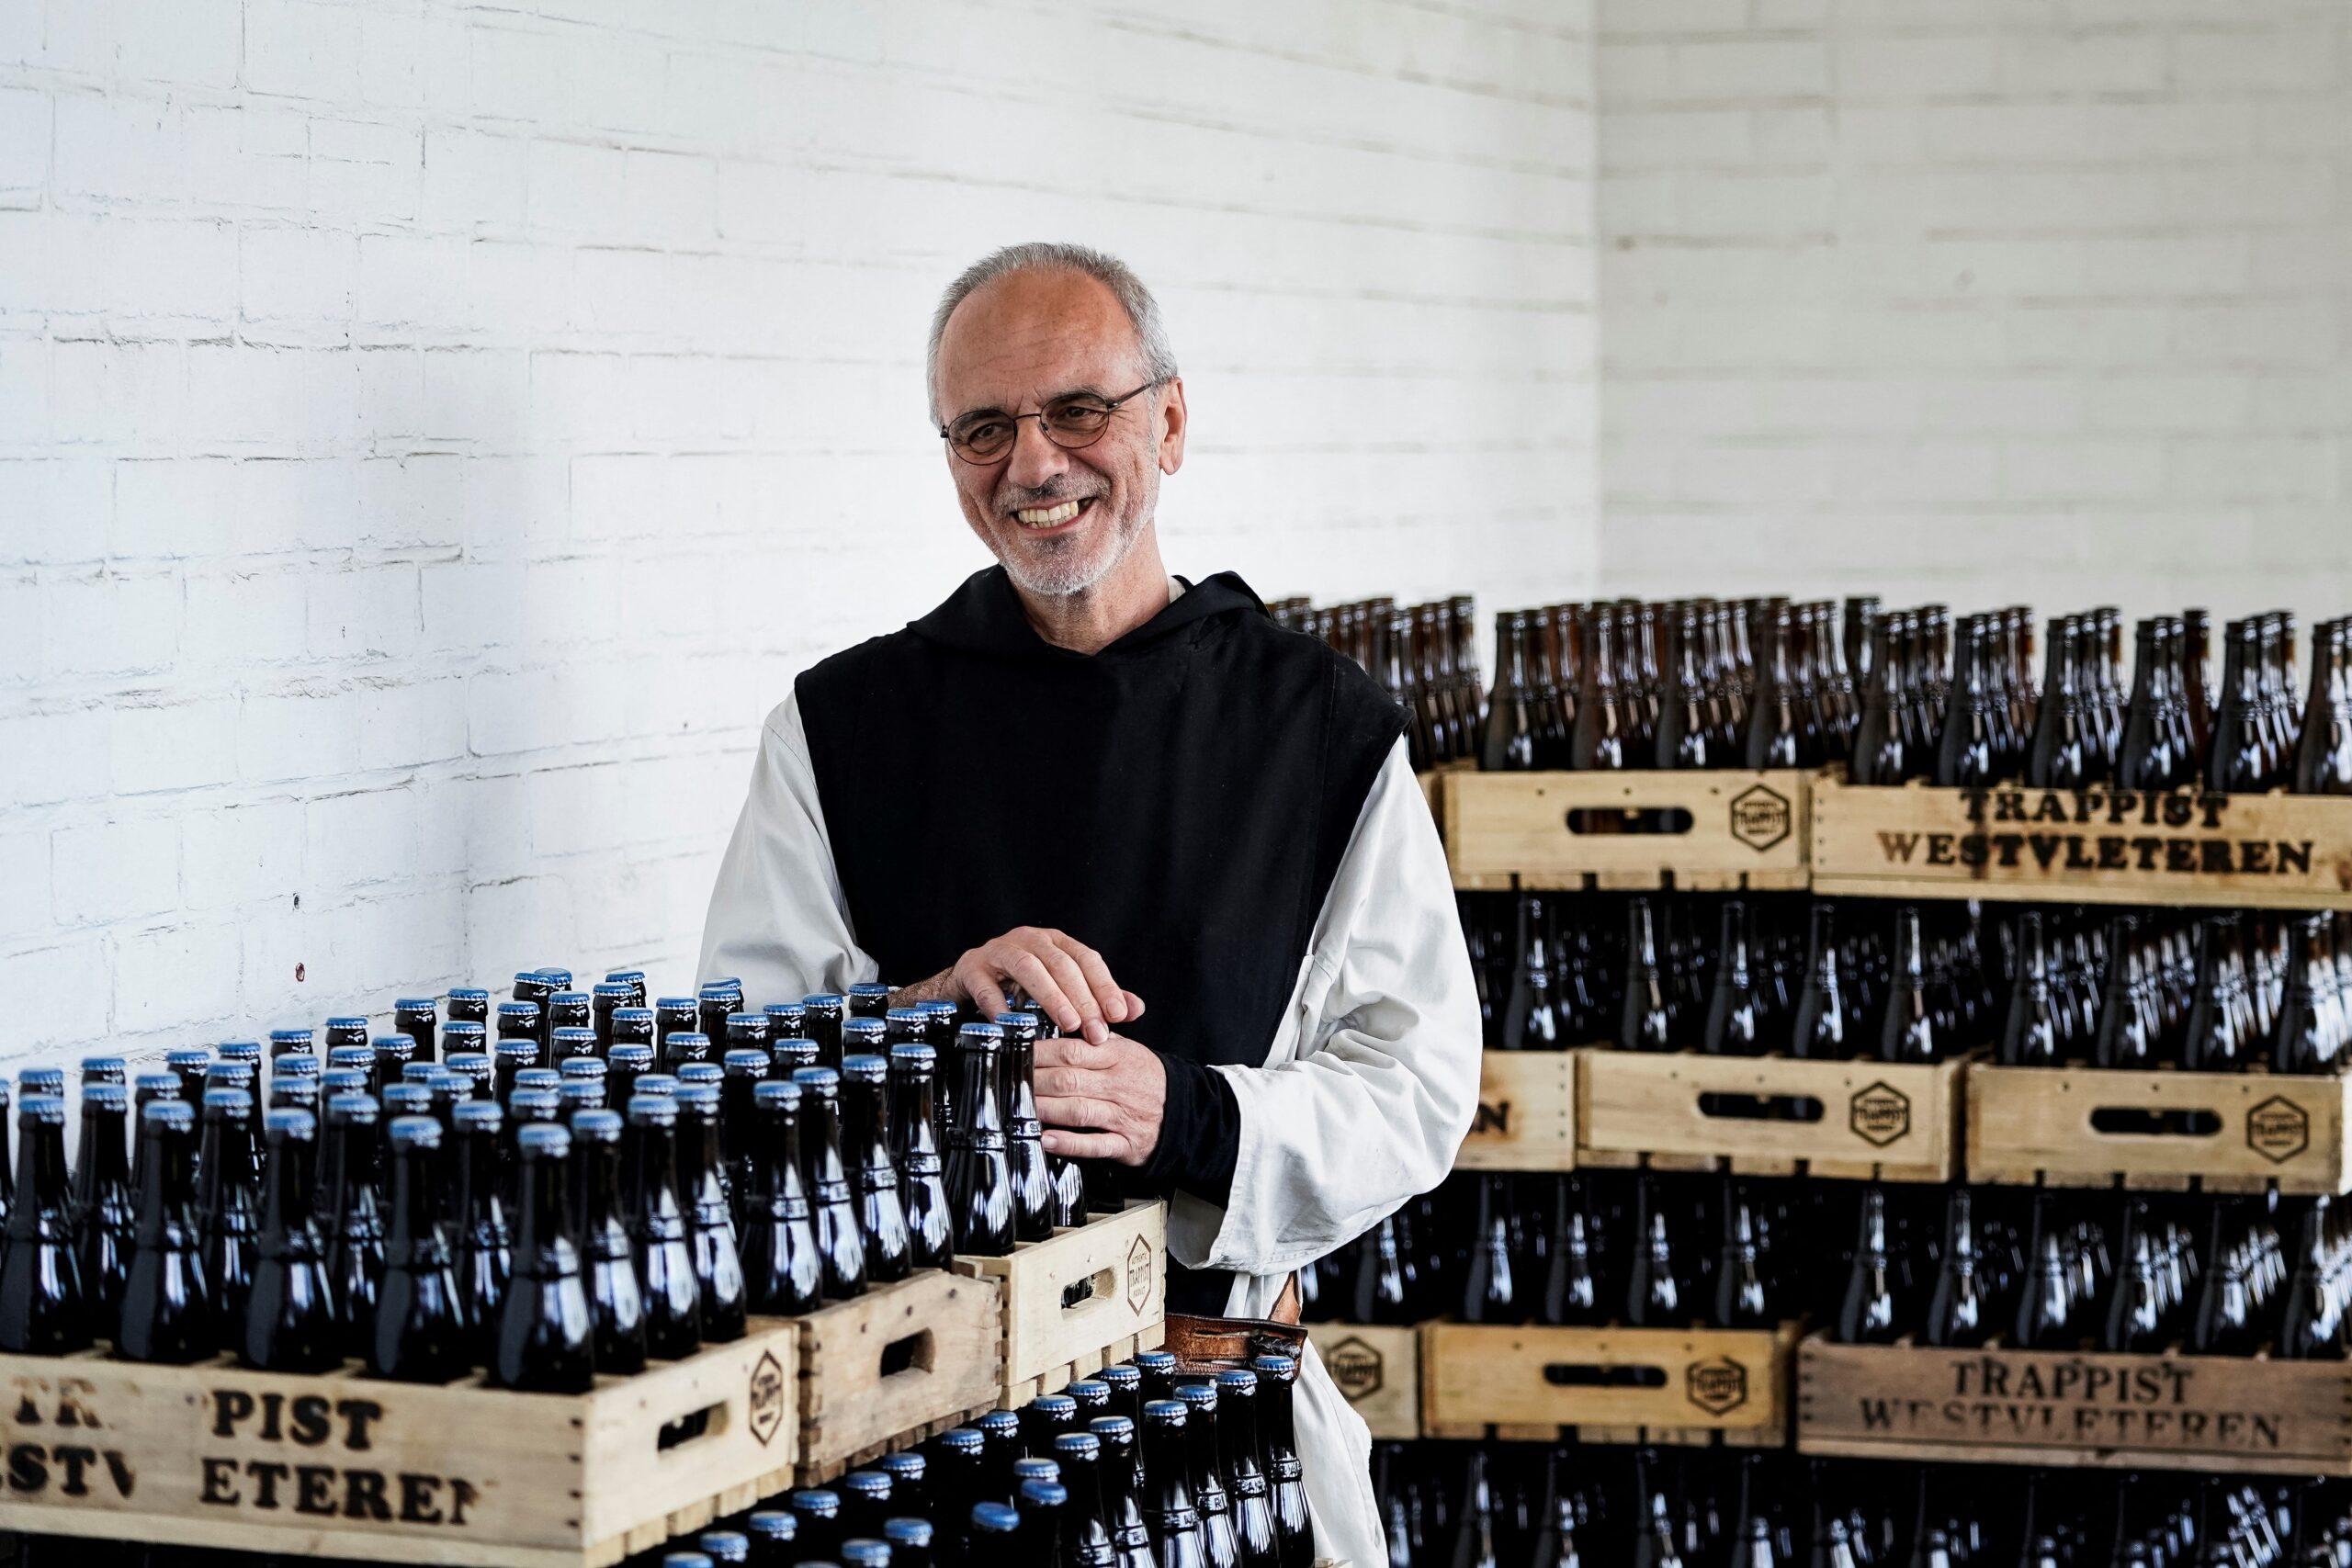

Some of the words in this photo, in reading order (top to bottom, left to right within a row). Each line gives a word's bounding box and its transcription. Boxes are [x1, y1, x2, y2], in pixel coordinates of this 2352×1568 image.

[1959, 791, 2230, 829] TRAPPIST
[1876, 830, 2315, 875] WESTVLETEREN
[1949, 1357, 2194, 1404] TRAPPIST
